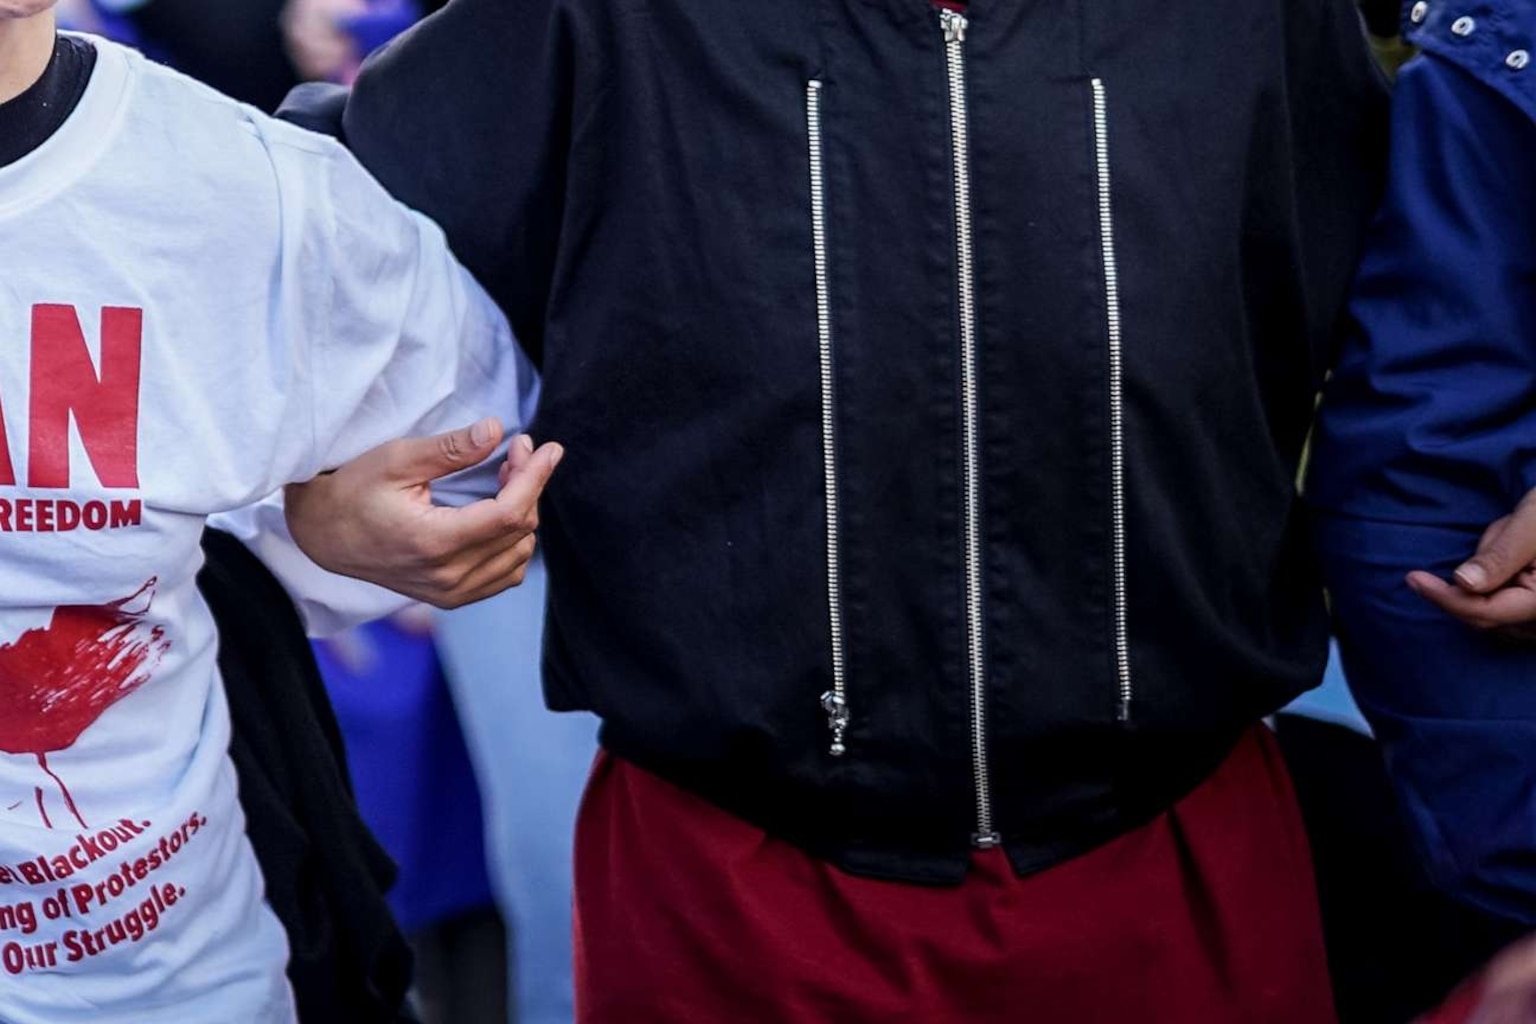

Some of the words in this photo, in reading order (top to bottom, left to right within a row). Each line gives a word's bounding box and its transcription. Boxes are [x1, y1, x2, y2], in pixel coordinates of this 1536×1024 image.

[17, 818, 152, 886] Blackout.
[42, 887, 71, 921] of
[71, 811, 208, 915] Protestors.
[2, 940, 59, 975] Our
[66, 880, 187, 963] Struggle.
